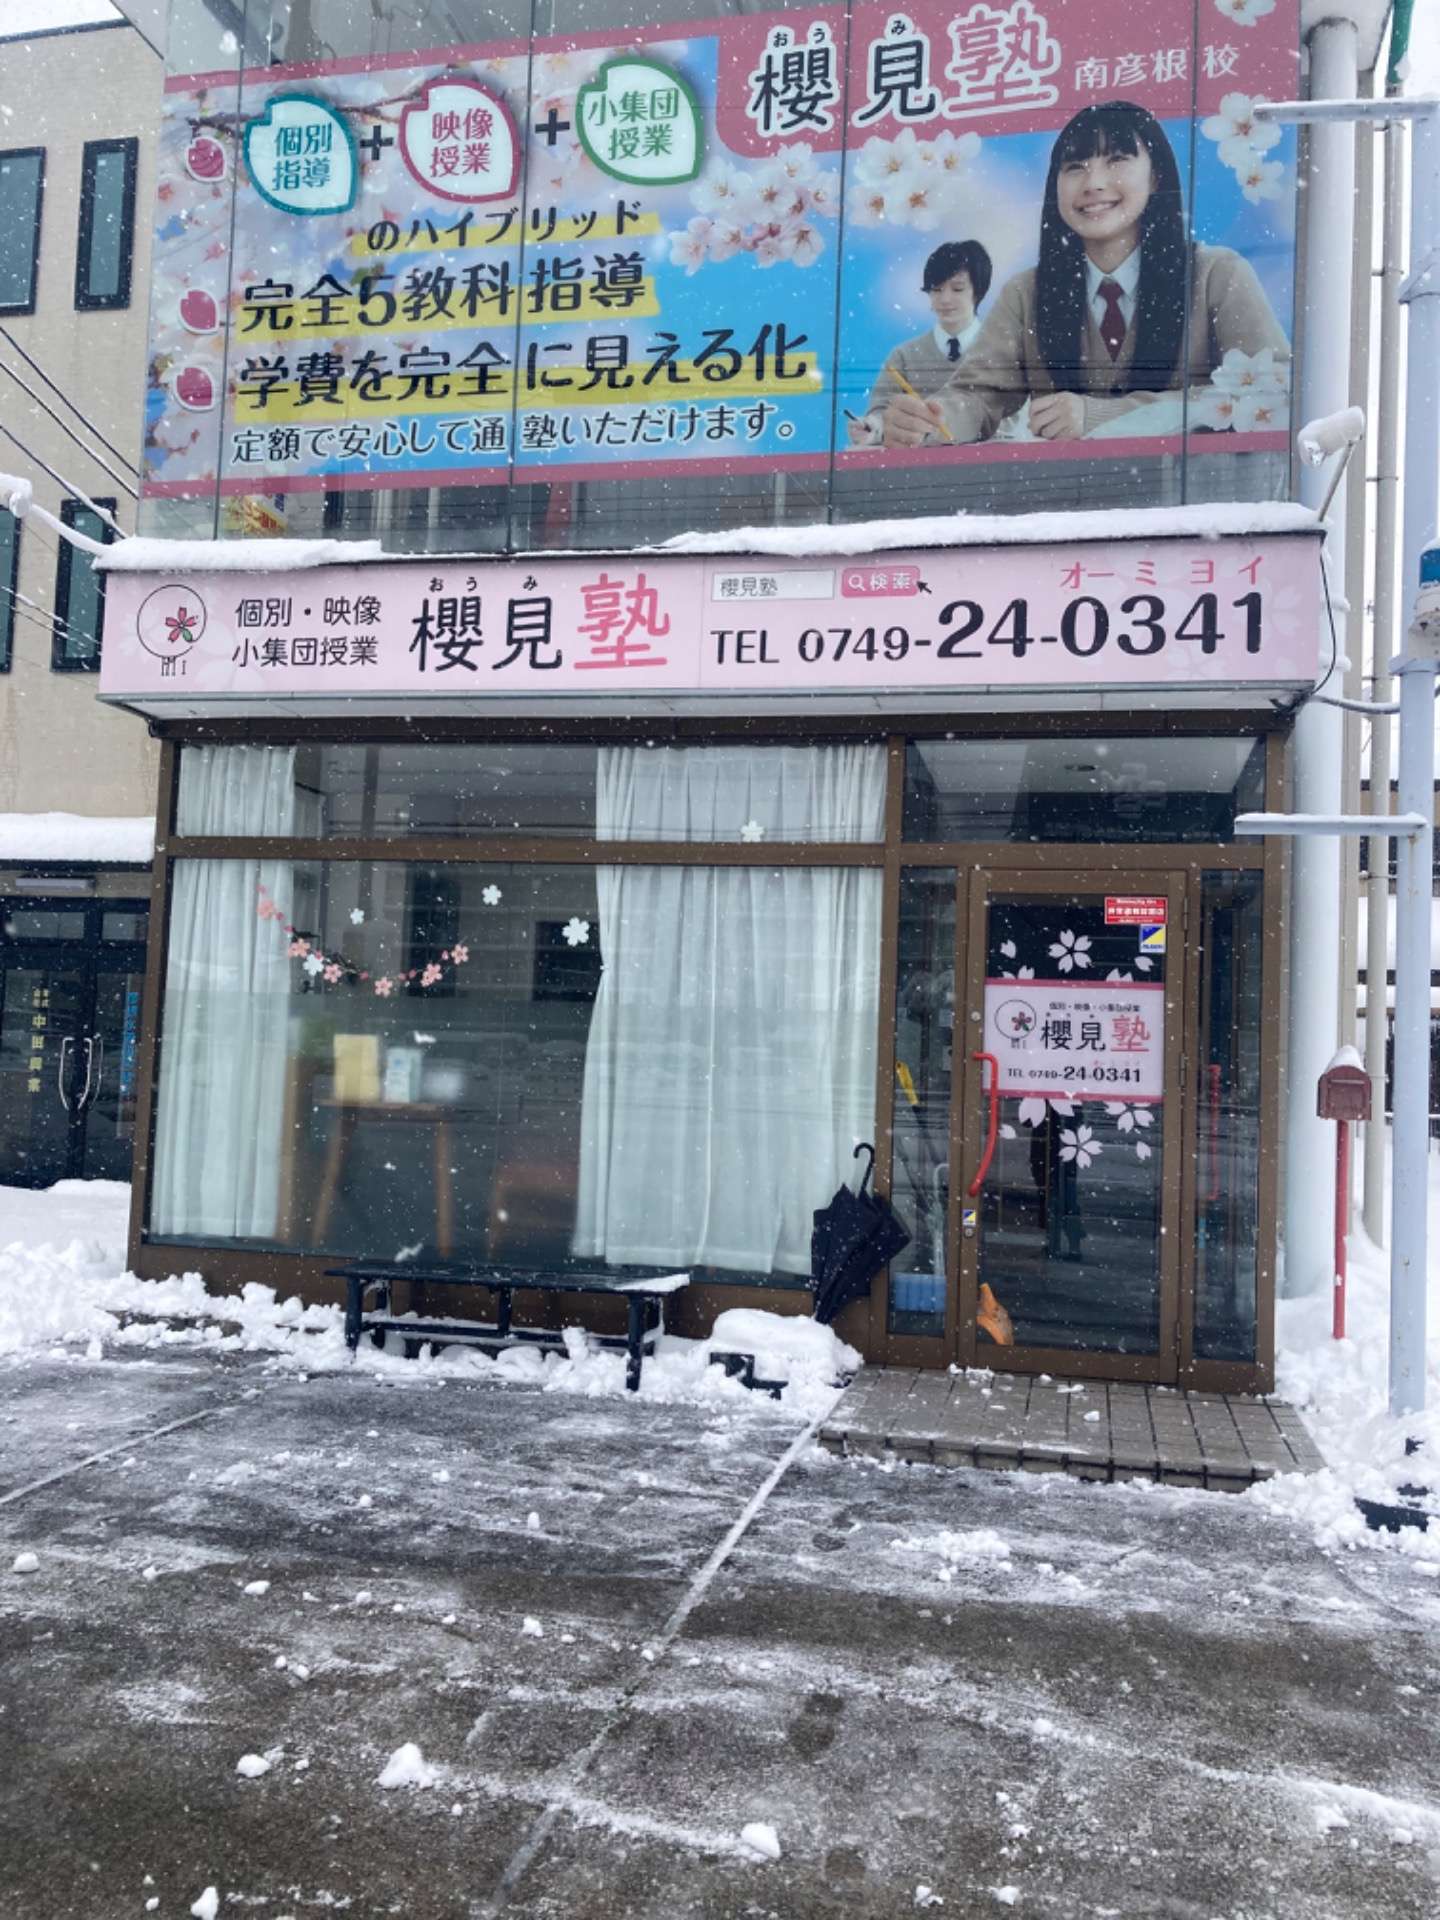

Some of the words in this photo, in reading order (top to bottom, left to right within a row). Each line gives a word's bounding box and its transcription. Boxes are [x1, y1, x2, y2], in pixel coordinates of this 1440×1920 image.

[750, 4, 1056, 130] 櫻見塾
[1074, 45, 1240, 91] 南彦根校
[432, 108, 493, 142] 映像
[589, 88, 679, 127] 小集団
[274, 123, 332, 156] 個別
[609, 123, 673, 159] 授業
[272, 157, 331, 190] 指導
[431, 142, 491, 177] 授業
[367, 200, 641, 251] のハイブリッド
[241, 252, 645, 332] 完全5教科指導
[239, 324, 808, 408] 学費を完全に見える化
[232, 402, 794, 464] 定額で安心して通塾いただけます。
[1061, 556, 1264, 588] オーミヨイ
[235, 595, 382, 628] 個別・映像
[408, 573, 670, 672] 櫻見塾
[710, 629, 780, 664] TEL
[798, 591, 1264, 663] 0749-24-0341
[231, 635, 379, 667] 小集団授業
[1040, 1014, 1151, 1052] 櫻見塾
[1008, 1068, 1024, 1078] TEL
